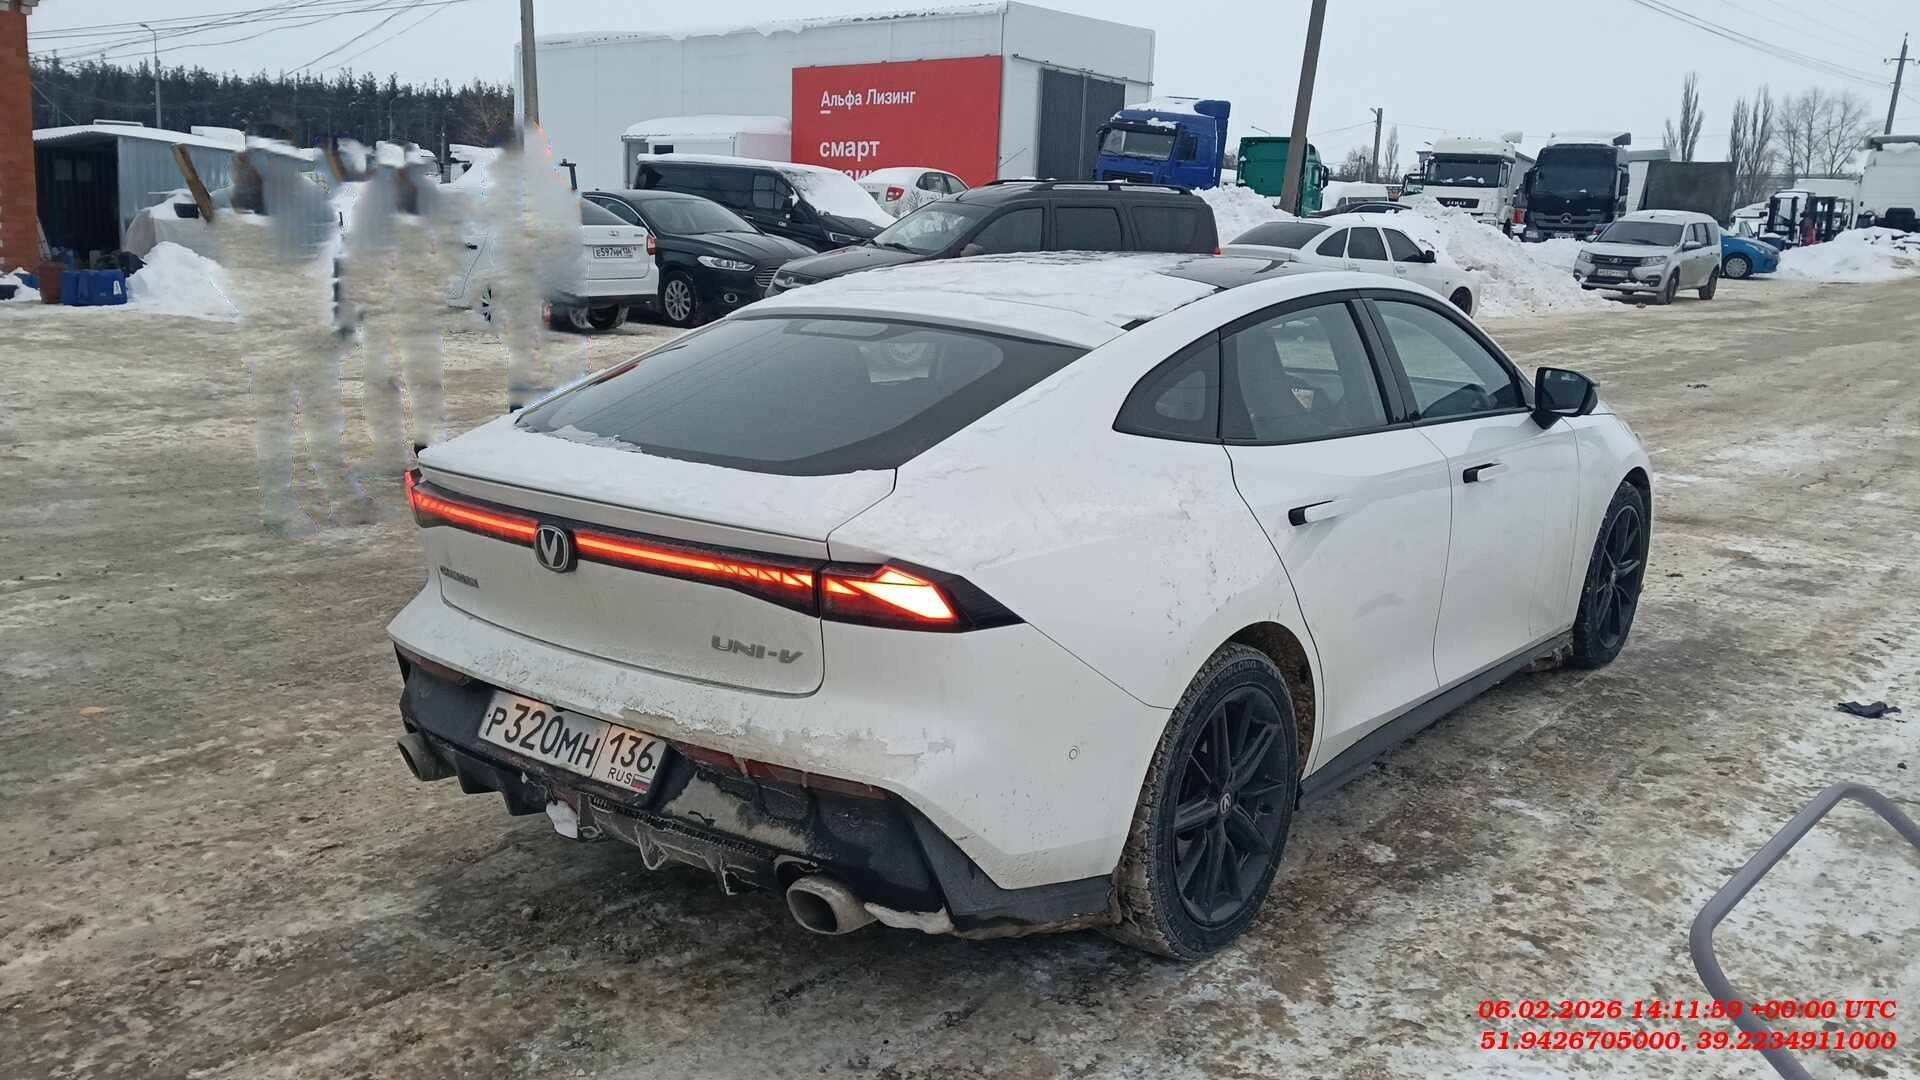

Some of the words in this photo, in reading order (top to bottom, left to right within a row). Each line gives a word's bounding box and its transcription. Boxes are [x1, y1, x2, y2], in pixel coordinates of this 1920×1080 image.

[820, 89, 863, 111] Альфа
[866, 88, 916, 105] Лизинг
[819, 140, 880, 162] смарт
[711, 634, 804, 664] UNI-V
[484, 703, 600, 770] Р320МН
[609, 731, 655, 773] 136
[607, 767, 633, 785] RUS
